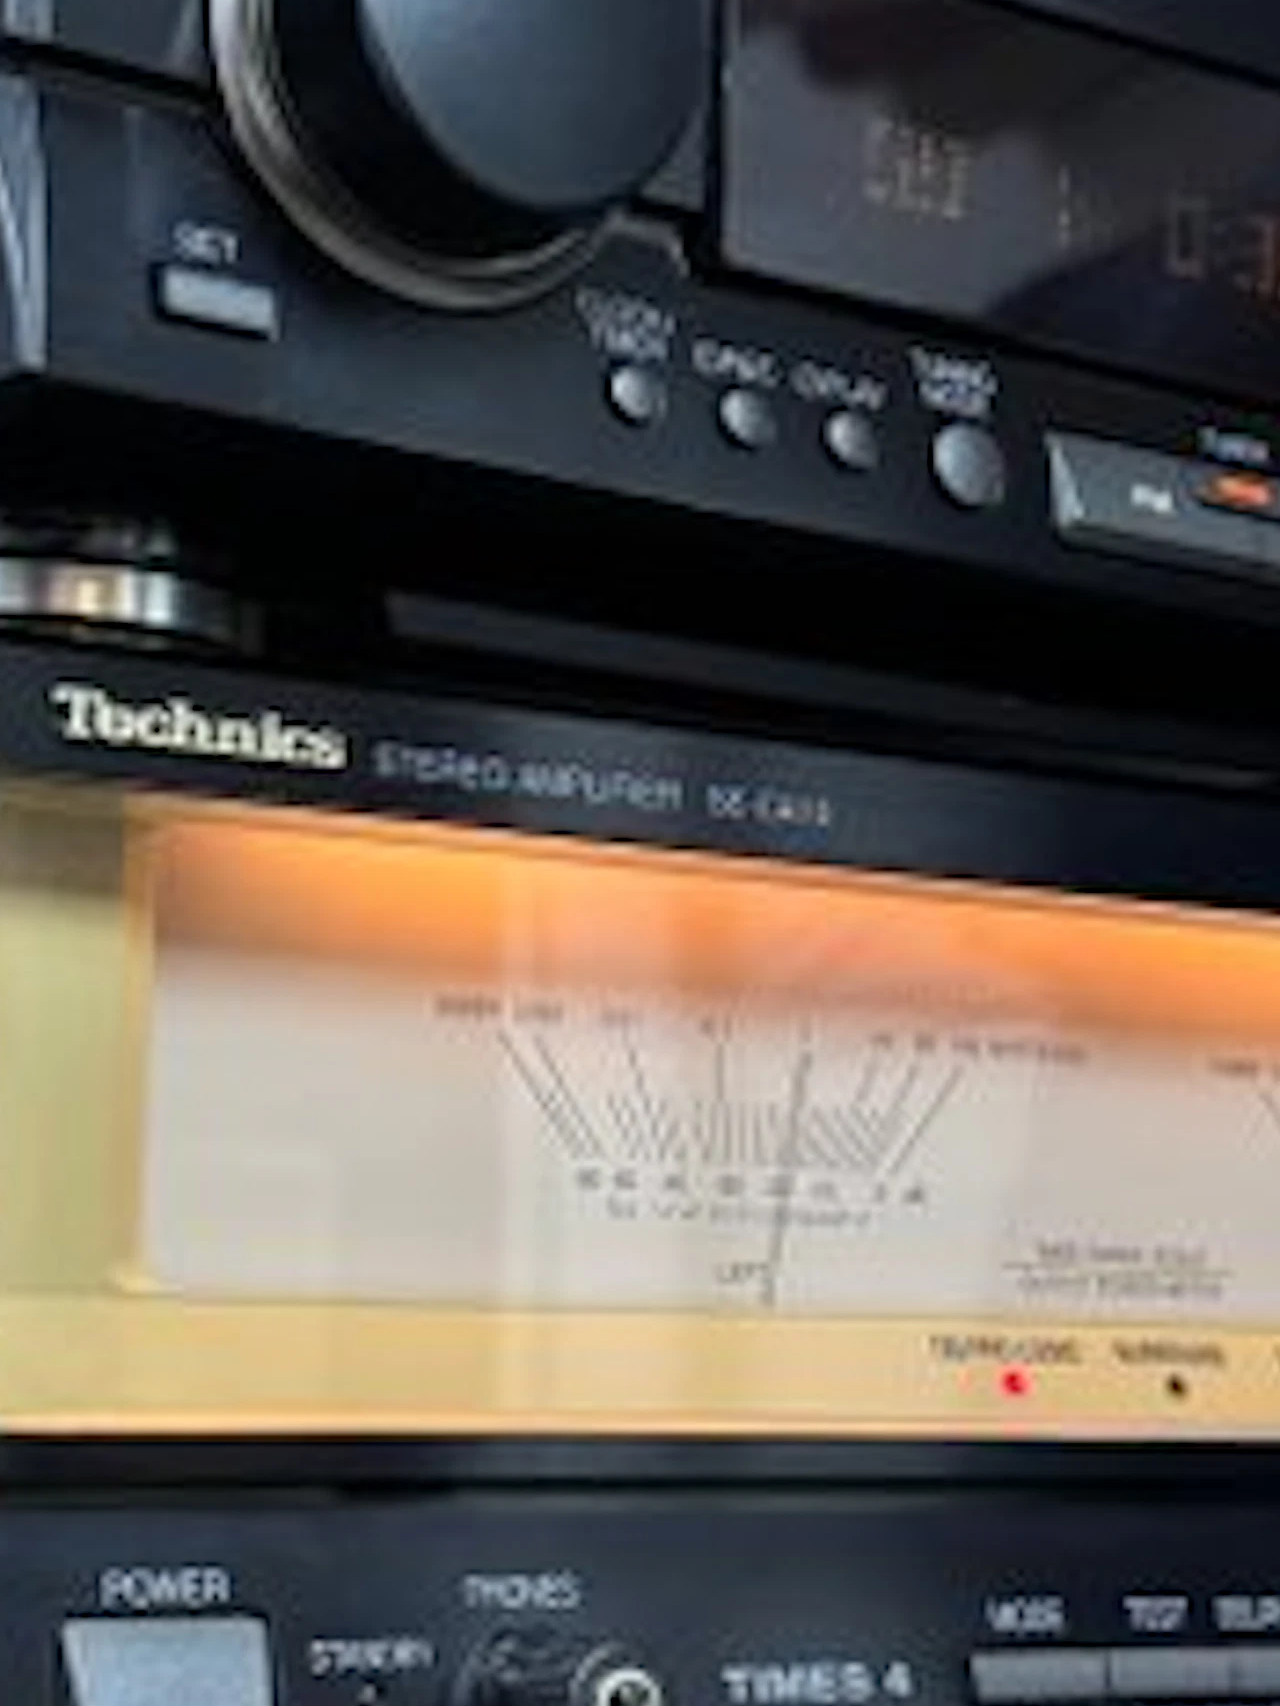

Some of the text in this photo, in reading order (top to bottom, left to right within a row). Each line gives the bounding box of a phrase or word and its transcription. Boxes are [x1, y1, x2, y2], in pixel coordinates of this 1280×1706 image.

[173, 223, 242, 265] SET
[52, 683, 350, 772] Technics
[374, 737, 510, 795] STEREO
[98, 1563, 234, 1611] POWER
